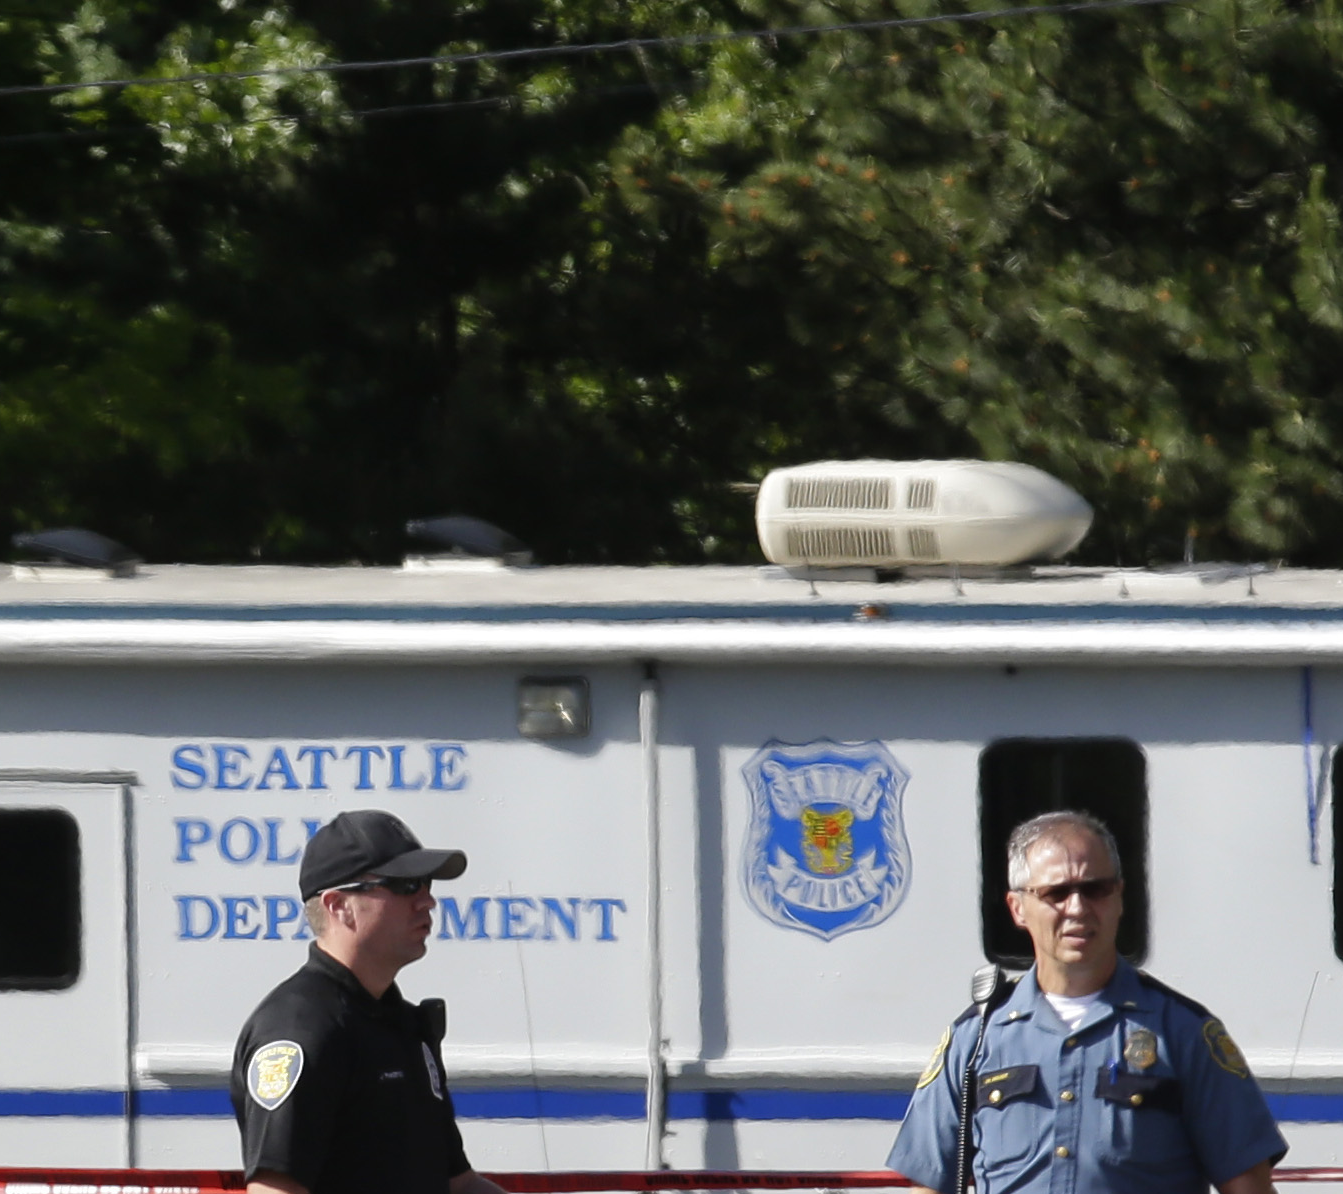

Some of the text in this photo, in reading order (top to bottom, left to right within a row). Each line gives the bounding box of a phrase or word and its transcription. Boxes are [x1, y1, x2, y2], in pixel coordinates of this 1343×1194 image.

[170, 743, 469, 791] SEATTLE
[785, 873, 874, 908] POLICE
[173, 895, 628, 941] DEPMENT
